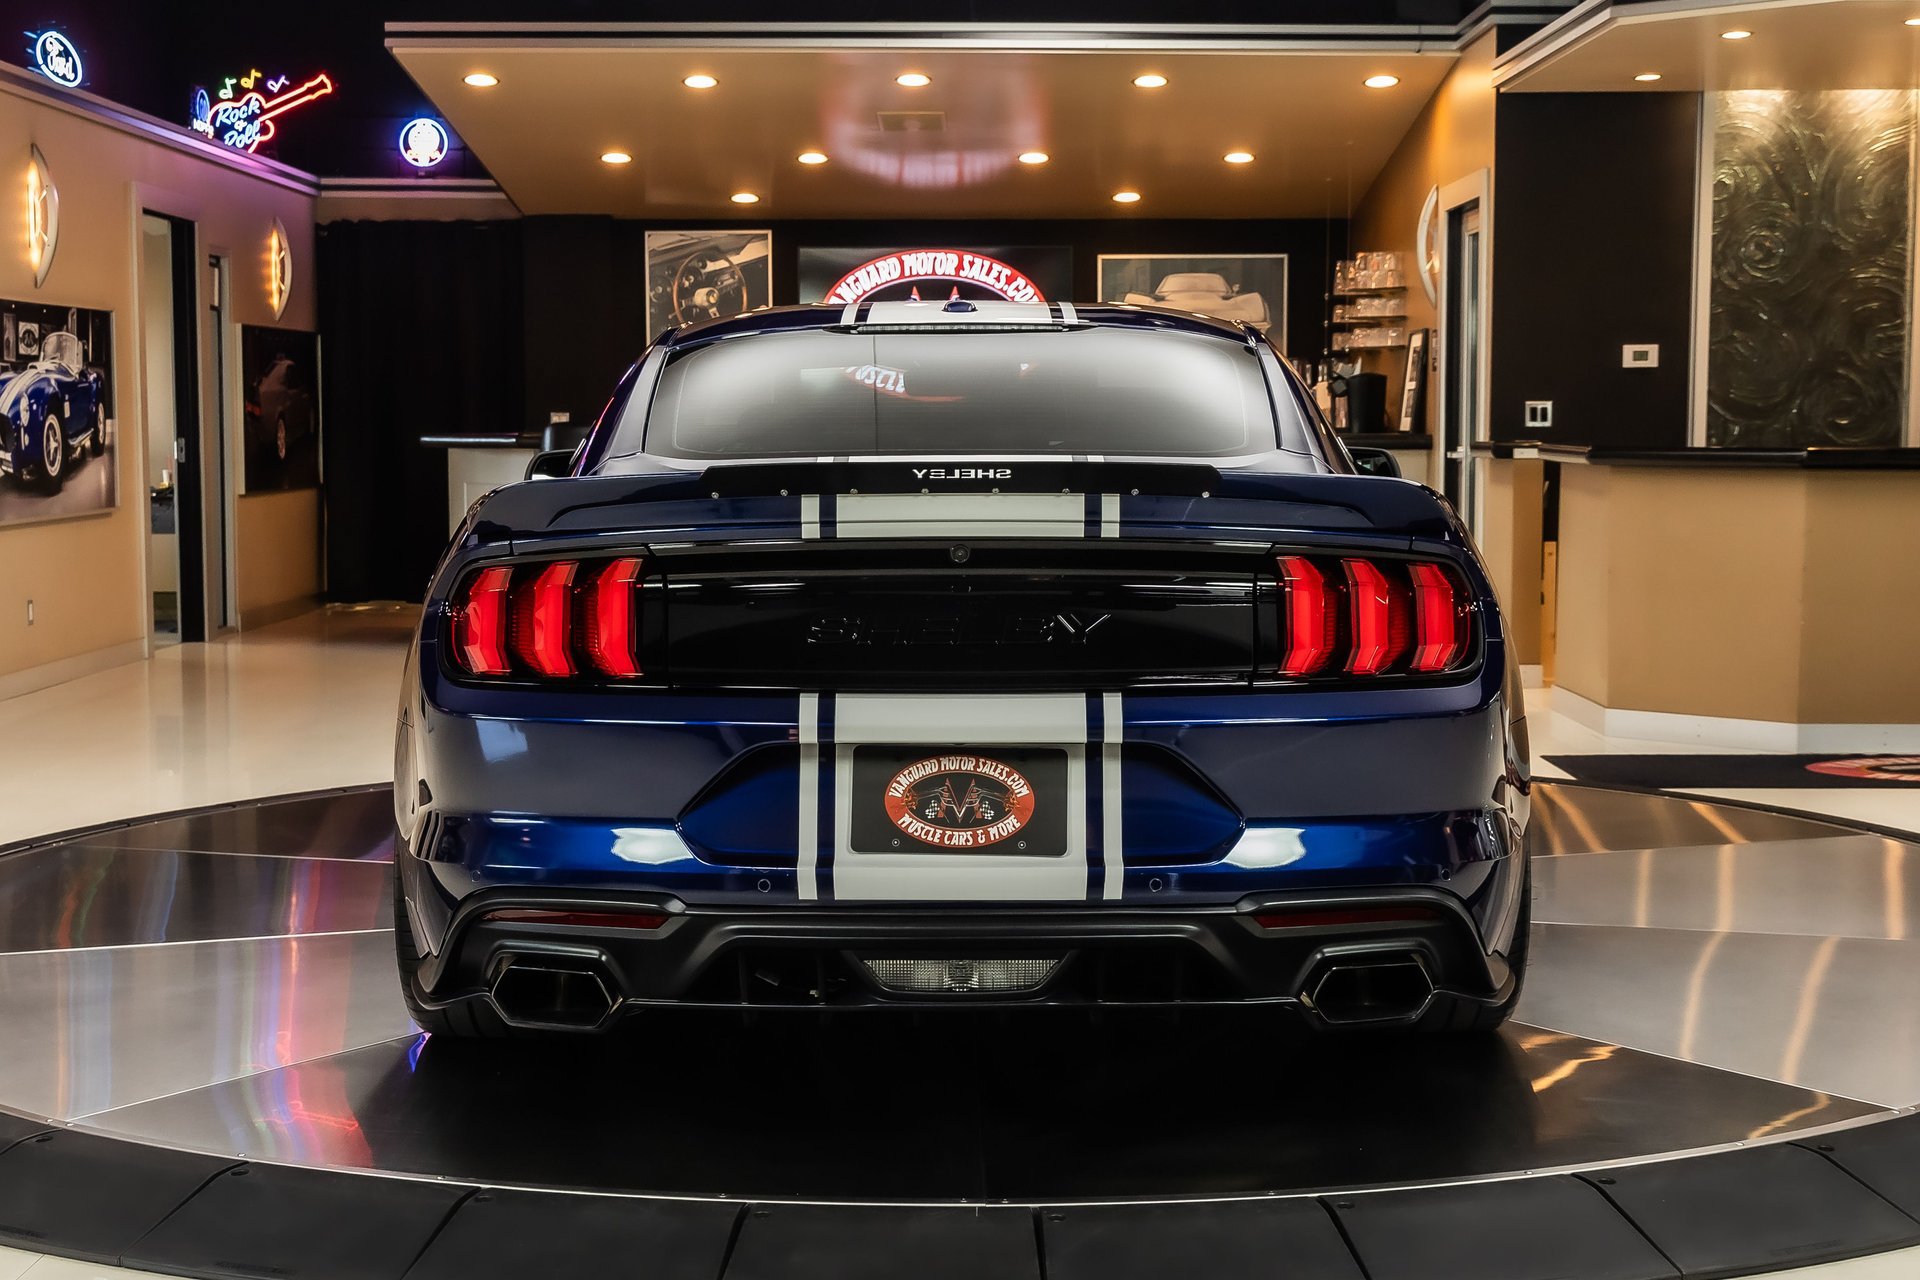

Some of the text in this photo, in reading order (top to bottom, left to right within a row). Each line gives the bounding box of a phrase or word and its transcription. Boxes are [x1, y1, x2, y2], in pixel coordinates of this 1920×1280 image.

[45, 36, 76, 81] Ford
[215, 95, 261, 128] Rock
[828, 256, 902, 304] ANGUARD
[901, 251, 959, 277] MOTOR
[889, 756, 1030, 798] VANGUARD MOTOR SALES.COM
[897, 813, 1021, 846] MUSCLE CARS & MORE
